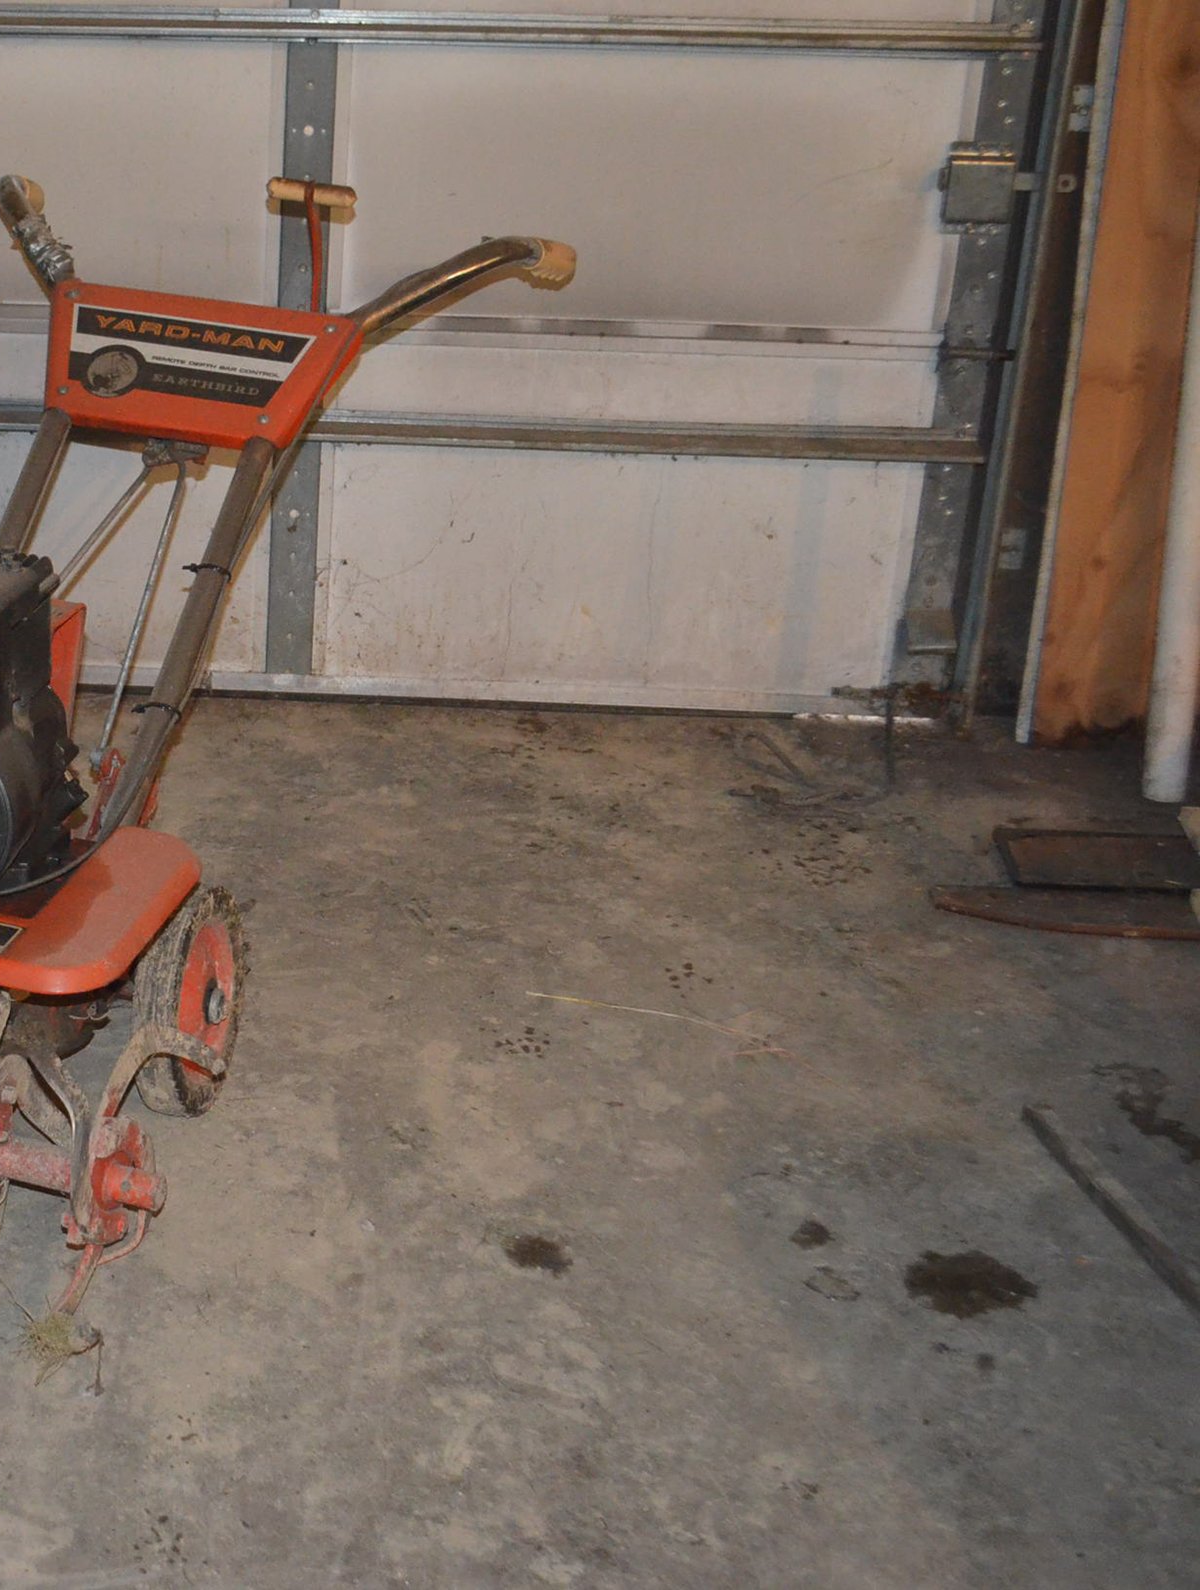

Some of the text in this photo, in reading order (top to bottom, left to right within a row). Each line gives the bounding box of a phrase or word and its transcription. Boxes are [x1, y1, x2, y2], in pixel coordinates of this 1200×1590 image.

[95, 314, 285, 353] YARD-MAN
[151, 355, 186, 365] REMOTE
[219, 365, 238, 373] BAR
[239, 367, 280, 378] CONTROL
[151, 373, 260, 396] EARTHBIRD
